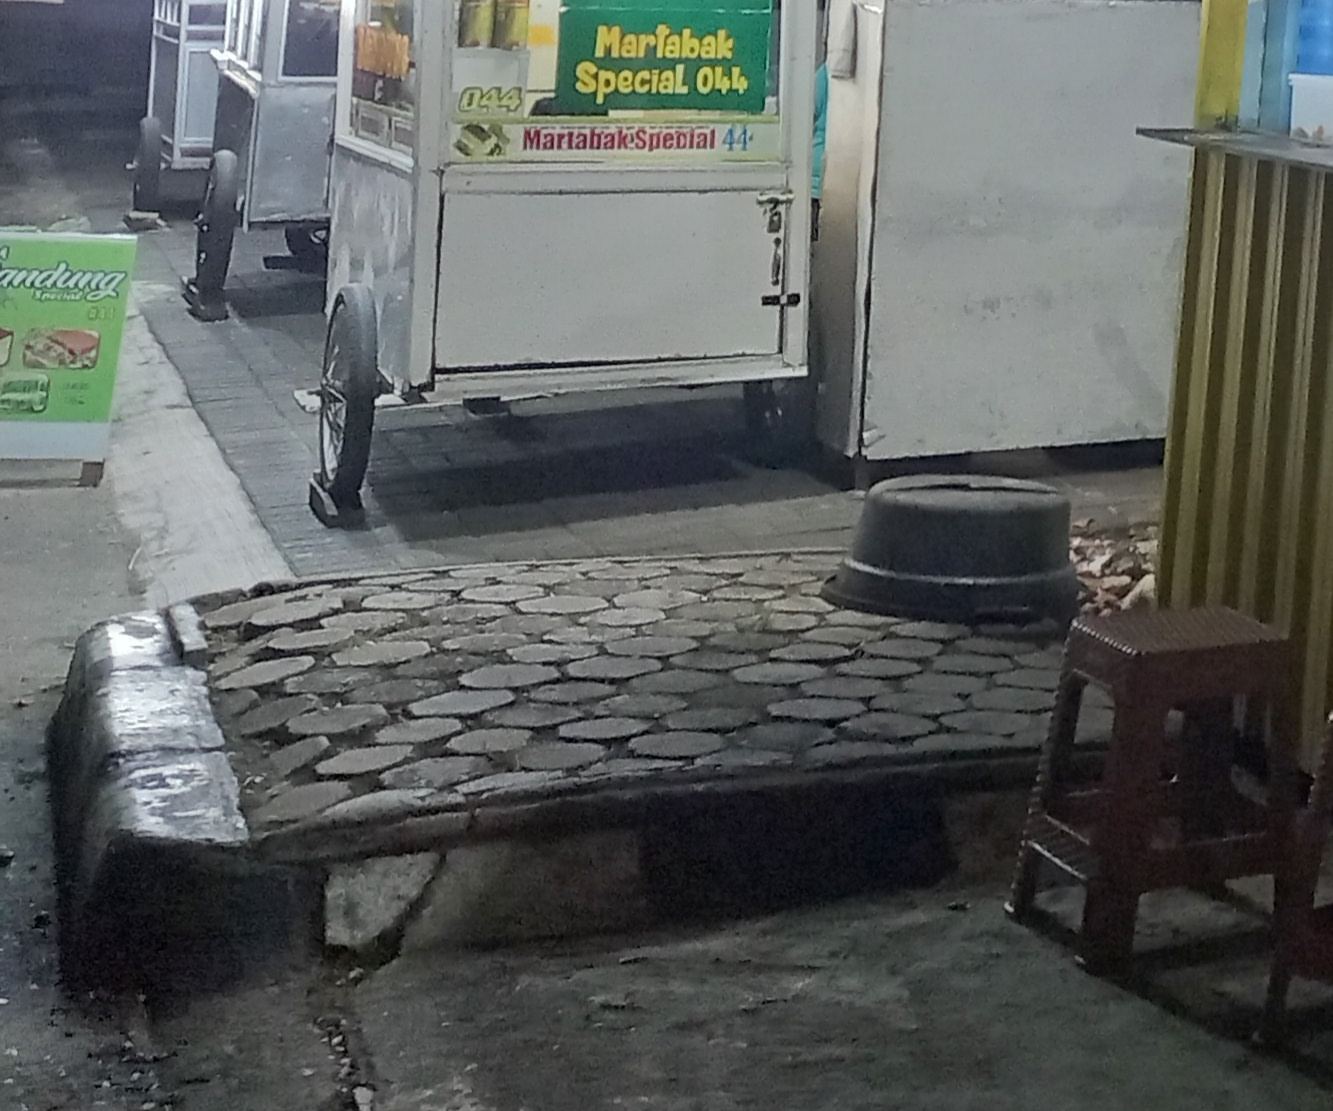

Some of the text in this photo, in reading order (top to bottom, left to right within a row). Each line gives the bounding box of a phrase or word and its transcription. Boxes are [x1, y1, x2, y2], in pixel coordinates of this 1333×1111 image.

[595, 24, 735, 59] Martabak
[696, 66, 748, 95] 044
[458, 87, 522, 112] 044
[0, 260, 126, 302] andung
